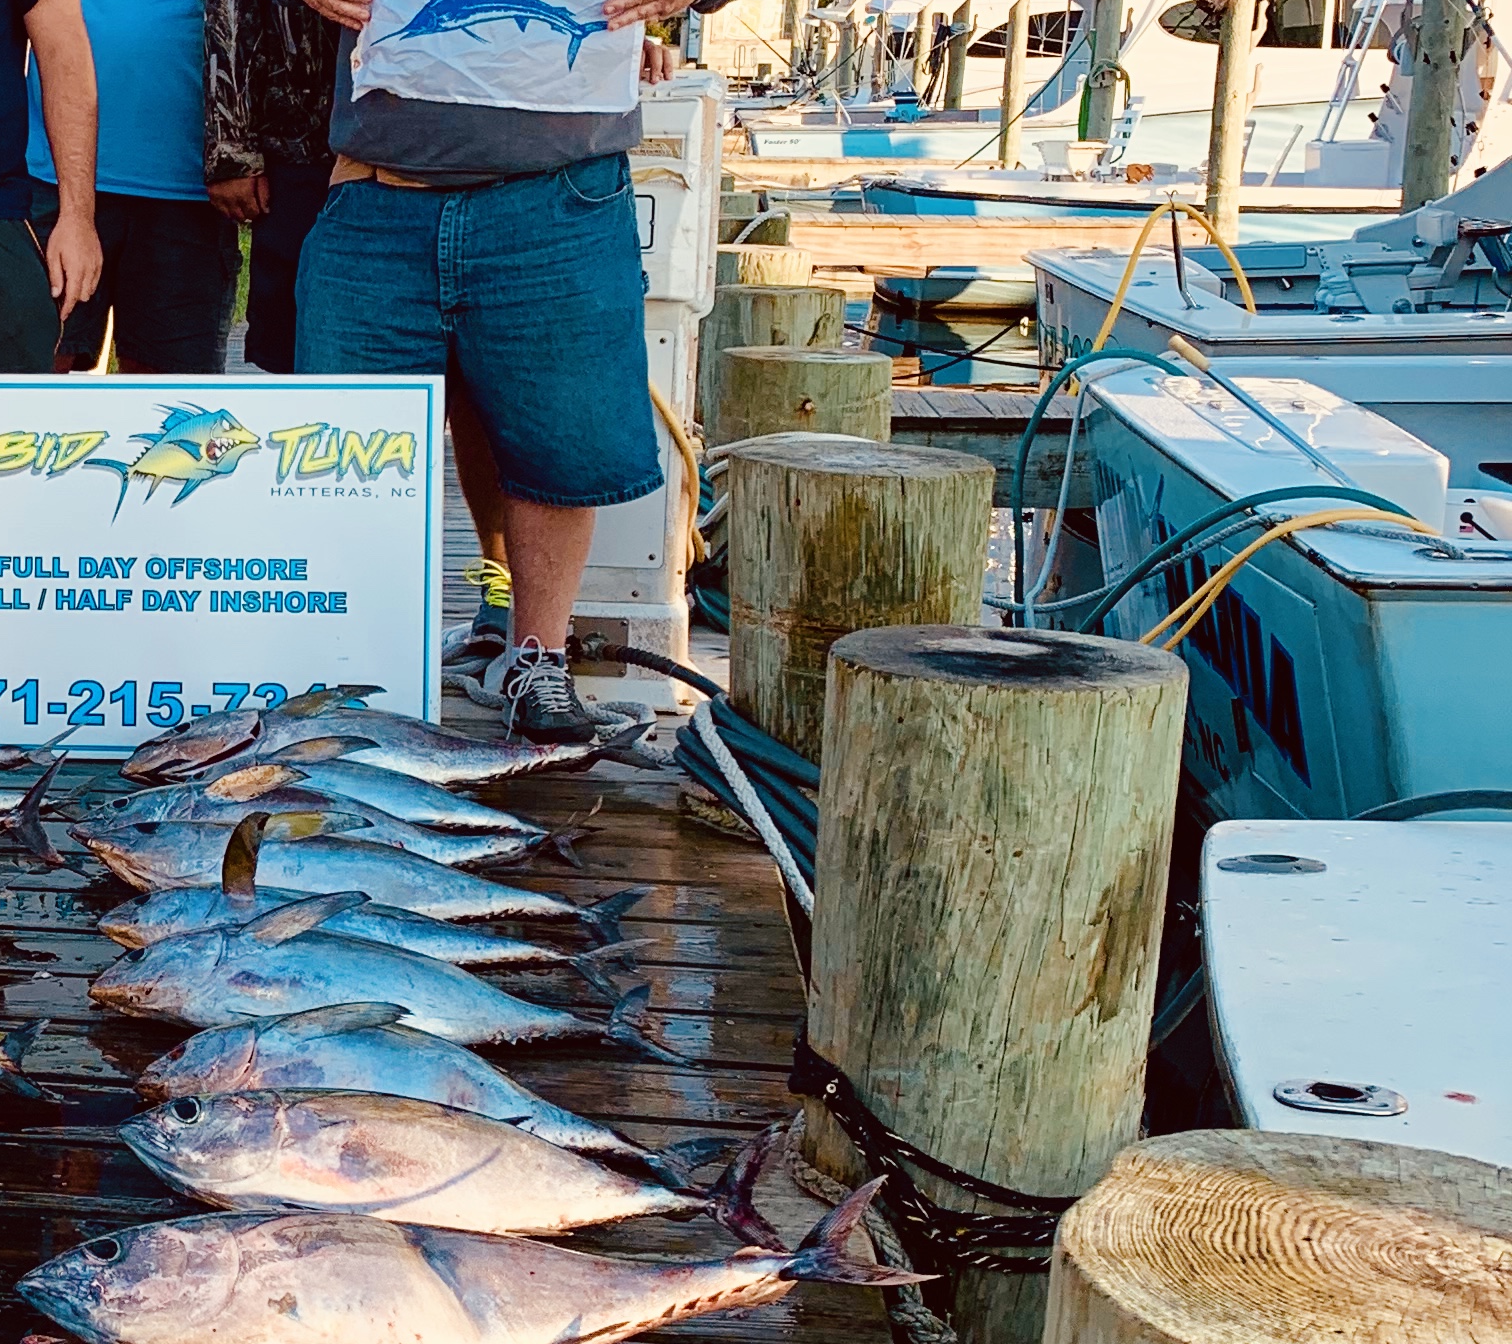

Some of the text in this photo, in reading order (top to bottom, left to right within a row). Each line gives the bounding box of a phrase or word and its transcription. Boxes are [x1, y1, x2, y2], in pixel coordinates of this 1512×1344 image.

[268, 422, 417, 479] TUNA
[270, 487, 417, 499] HATTERAS, NC
[78, 557, 138, 579] DAY
[145, 557, 308, 581] OFFSHORE
[37, 588, 47, 610] /
[55, 589, 133, 611] HALF
[142, 590, 202, 612] DAY
[210, 590, 347, 614] INSHORE
